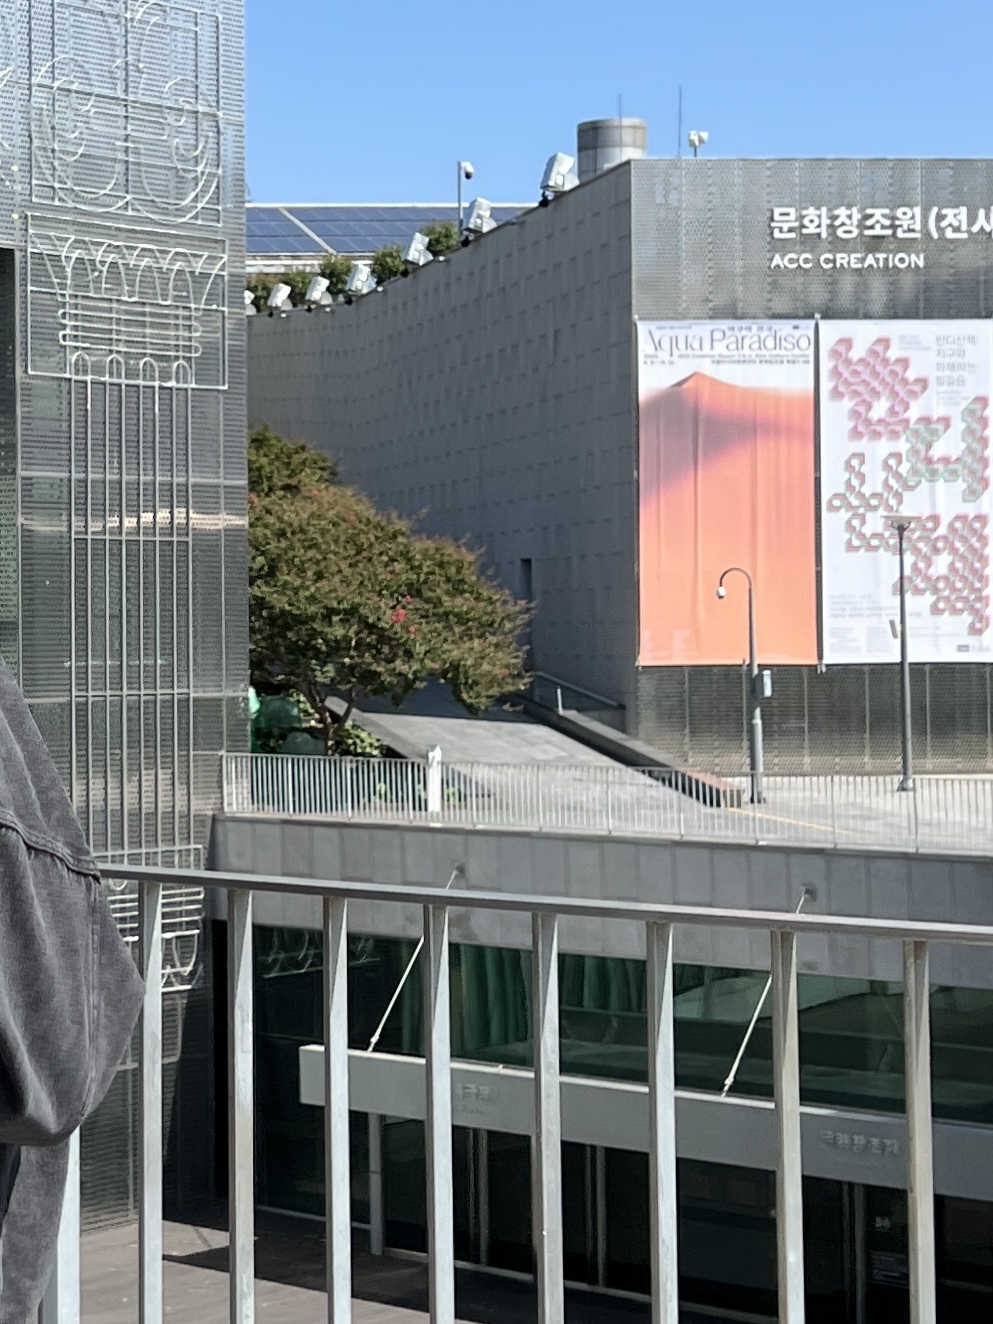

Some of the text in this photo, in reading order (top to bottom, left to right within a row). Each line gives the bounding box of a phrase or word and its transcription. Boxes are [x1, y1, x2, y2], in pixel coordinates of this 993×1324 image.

[770, 252, 925, 269] ACC CREATION
[648, 328, 812, 357] Aqua Paradiso
